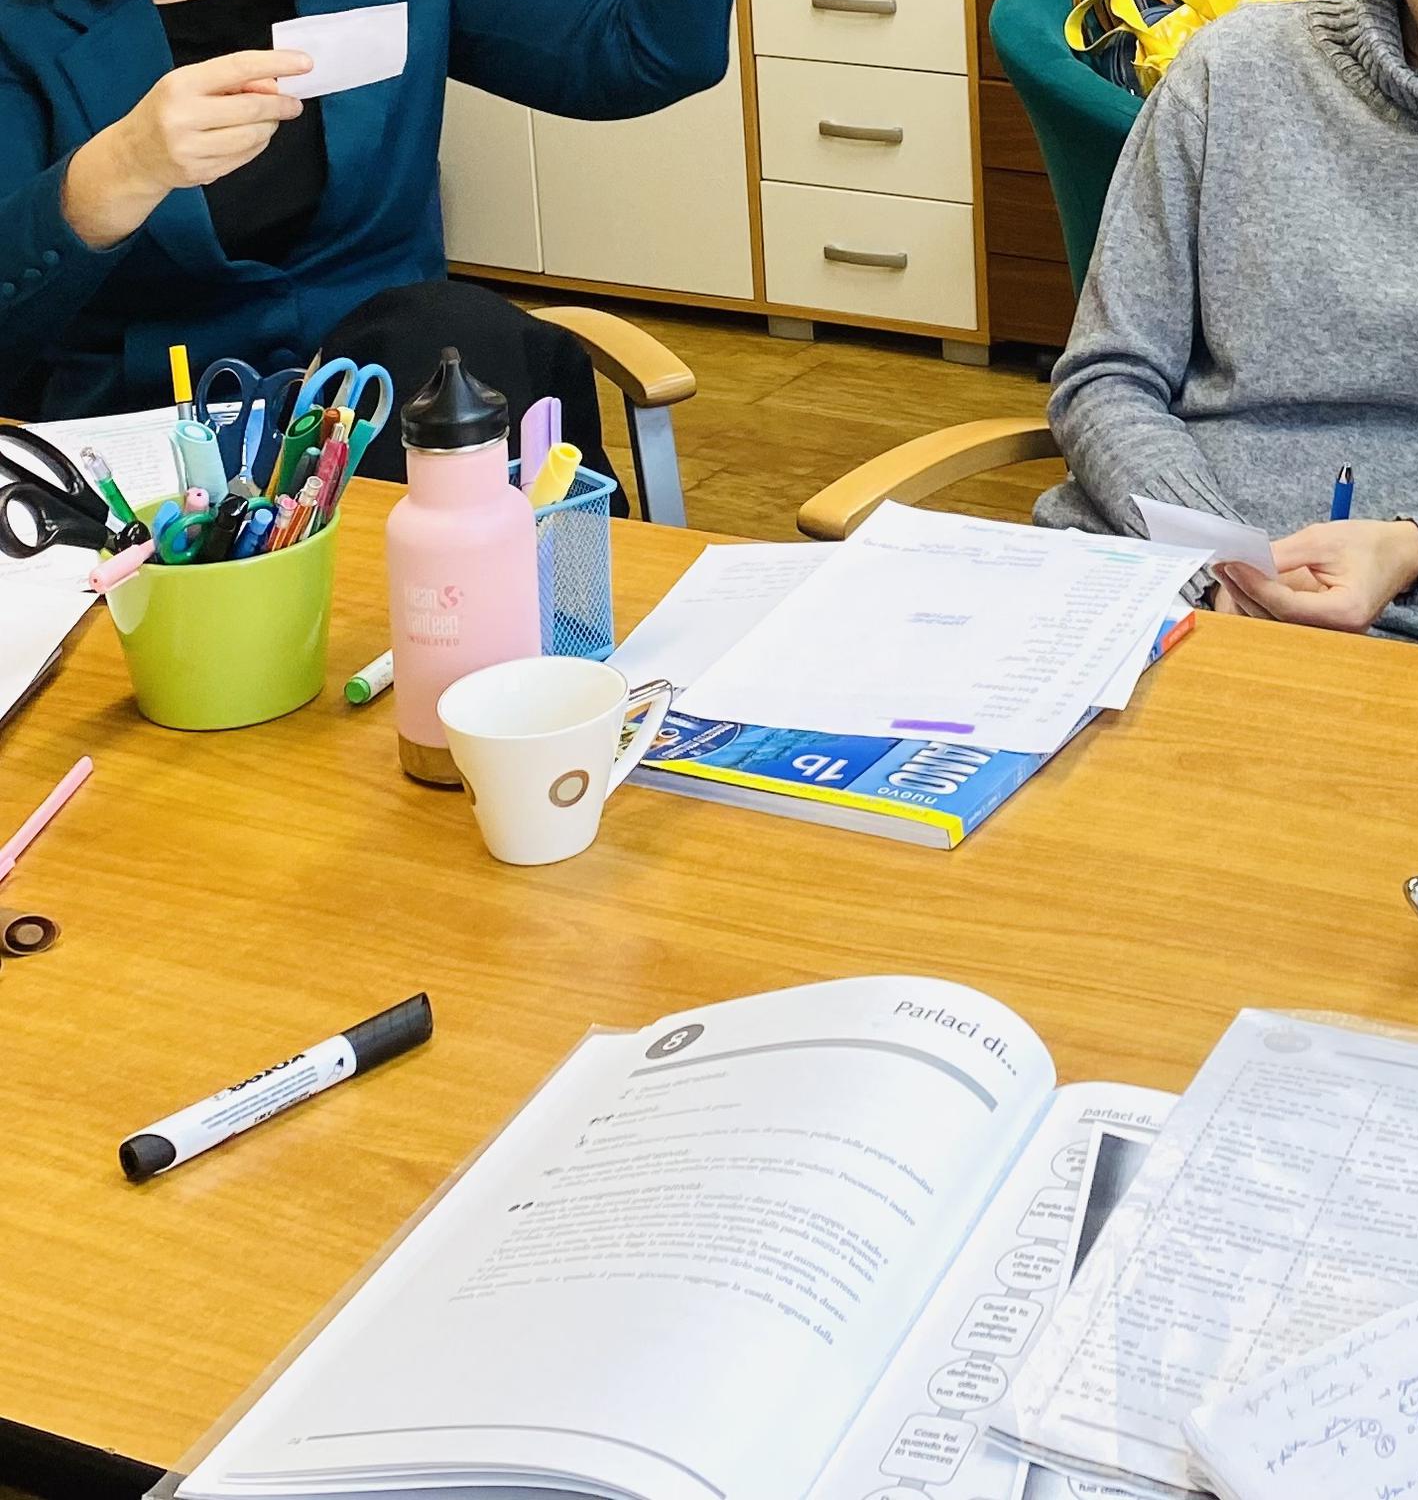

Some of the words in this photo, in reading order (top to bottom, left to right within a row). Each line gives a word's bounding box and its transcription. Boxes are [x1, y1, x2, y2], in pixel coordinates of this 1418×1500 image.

[792, 754, 849, 782] 1b
[888, 740, 996, 795] ANO
[876, 786, 939, 805] nuovo
[661, 1030, 689, 1053] 8
[894, 999, 982, 1040] Parlaci
